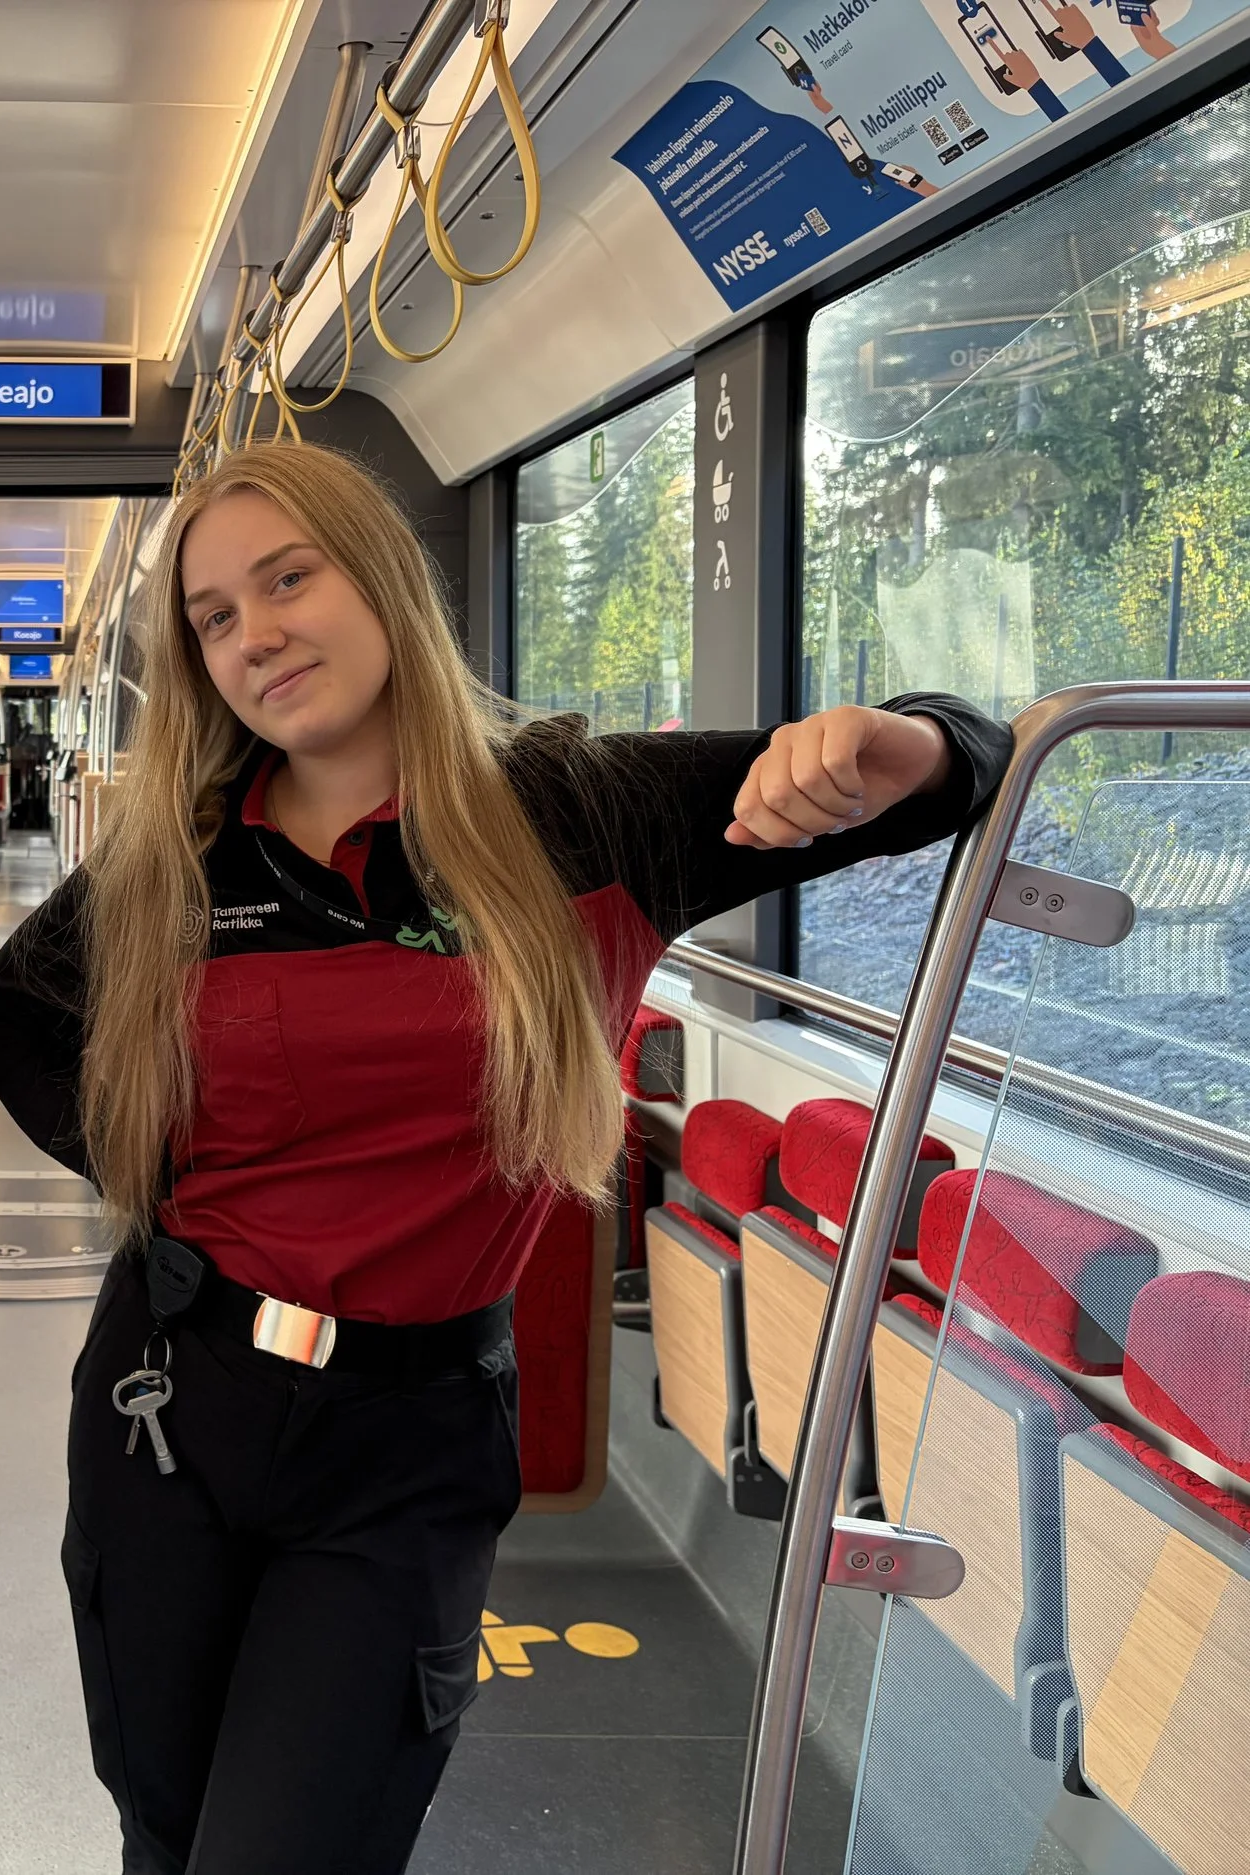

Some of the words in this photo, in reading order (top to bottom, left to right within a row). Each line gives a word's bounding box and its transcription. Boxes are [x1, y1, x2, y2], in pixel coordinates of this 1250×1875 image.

[803, 0, 878, 53] Matkako
[819, 48, 840, 70] Travel
[837, 40, 854, 60] card
[860, 71, 948, 139] Mobiililippu
[645, 148, 675, 175] Vahvista
[668, 128, 695, 155] lippusi
[691, 94, 734, 137] voimassaolo
[876, 133, 900, 155] Mobile
[897, 123, 919, 145] ticket
[657, 163, 689, 195] jokaisella
[686, 139, 719, 169] matkalla.
[783, 222, 810, 247] nysse.fi
[712, 230, 778, 286] NYSSE
[212, 902, 280, 918] Tampereen
[212, 916, 264, 930] Ratikka
[327, 908, 349, 922] care
[349, 919, 365, 930] We
